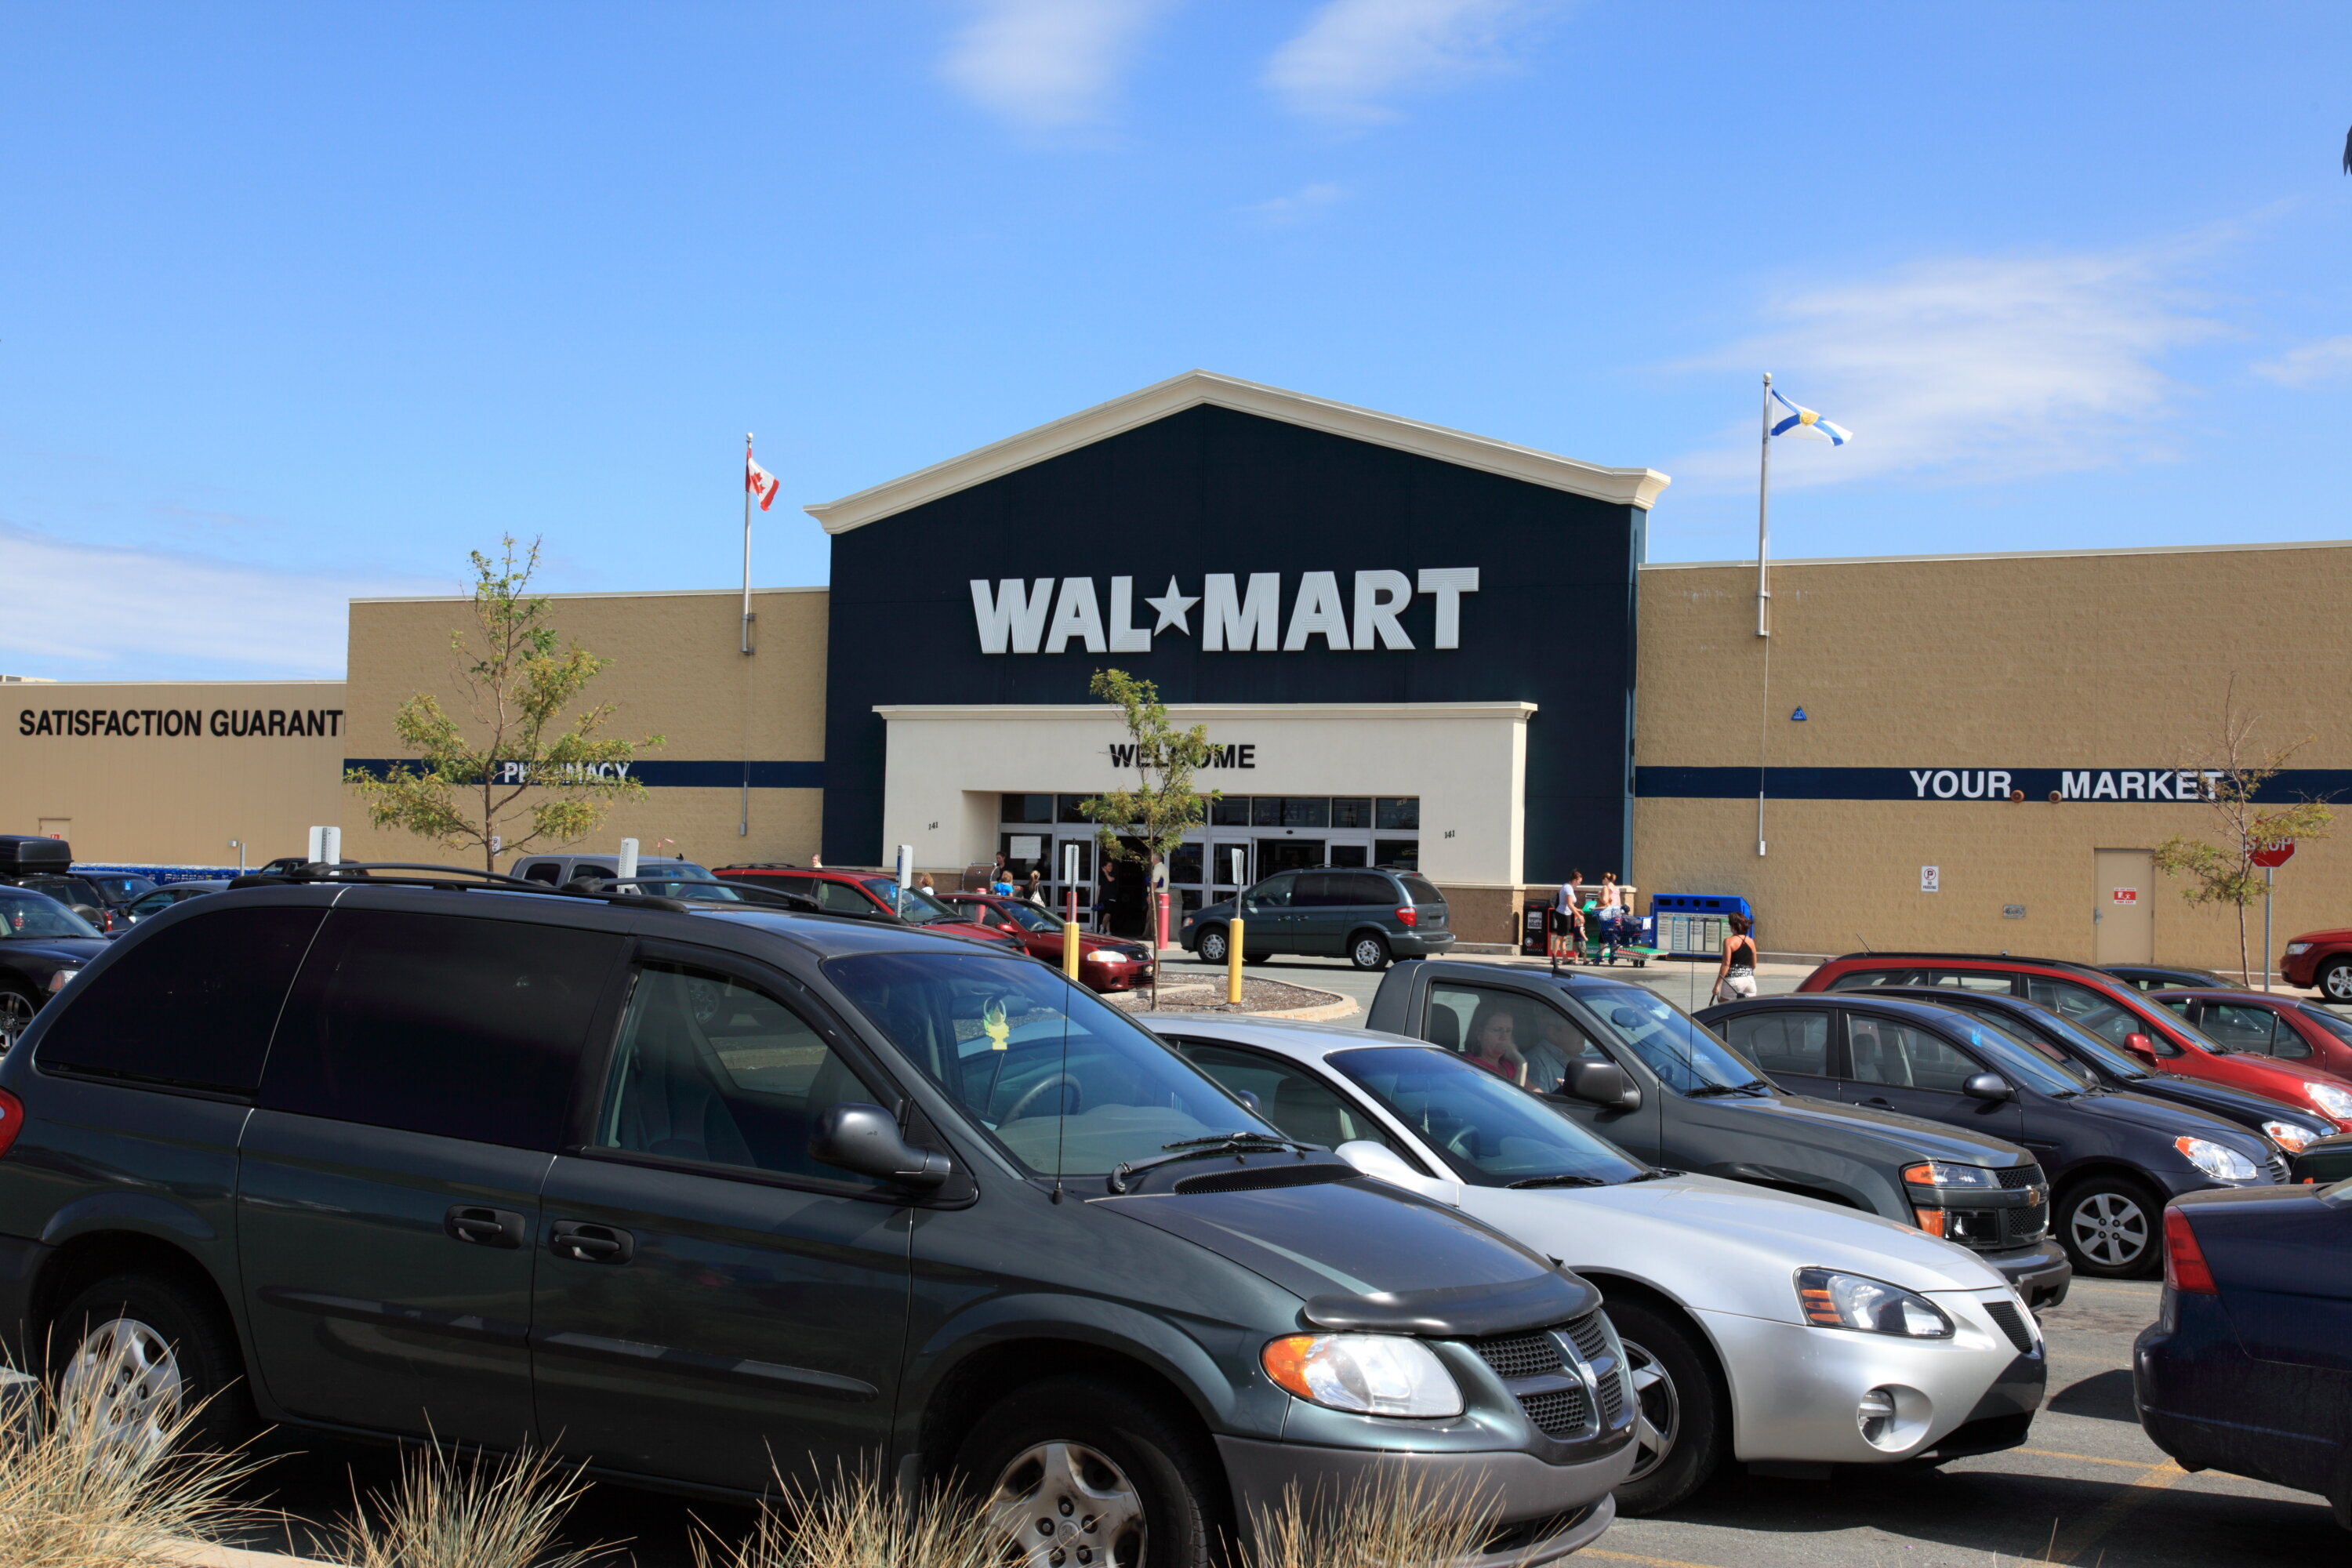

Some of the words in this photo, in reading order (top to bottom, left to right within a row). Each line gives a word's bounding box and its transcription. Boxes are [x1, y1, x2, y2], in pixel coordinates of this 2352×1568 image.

[1203, 566, 1480, 652] MART
[19, 710, 201, 736] SATISFACTION
[210, 710, 346, 737] GUARANT
[1910, 771, 2012, 799] YOUR
[2061, 771, 2224, 800] MARKET
[928, 821, 938, 831] 141
[1444, 829, 1455, 839] 141
